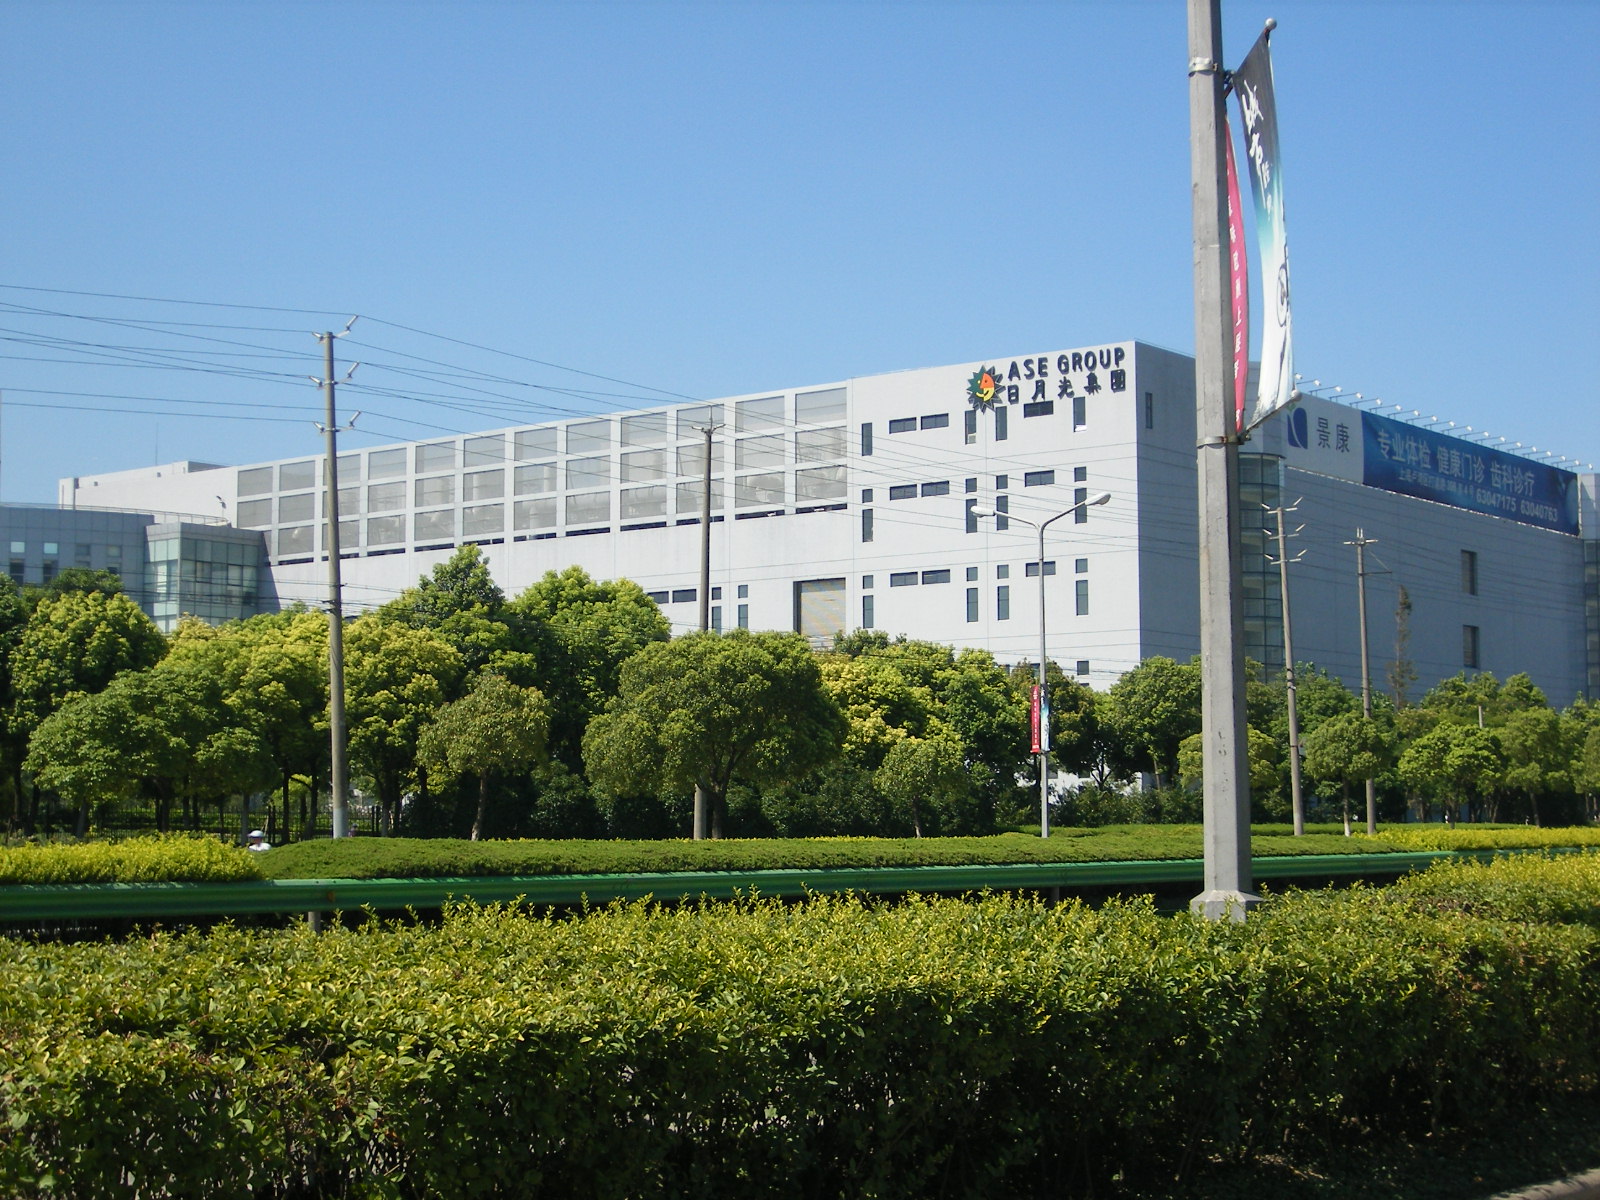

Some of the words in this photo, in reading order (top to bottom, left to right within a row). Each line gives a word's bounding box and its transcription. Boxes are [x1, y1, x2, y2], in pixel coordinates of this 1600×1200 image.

[1008, 357, 1049, 381] ASE
[1057, 347, 1126, 375] GROUP
[1315, 417, 1350, 453] 景康
[1377, 428, 1431, 470] 专业体检
[1437, 445, 1485, 483] 健康门诊
[1490, 460, 1535, 497] 齿科诊疗
